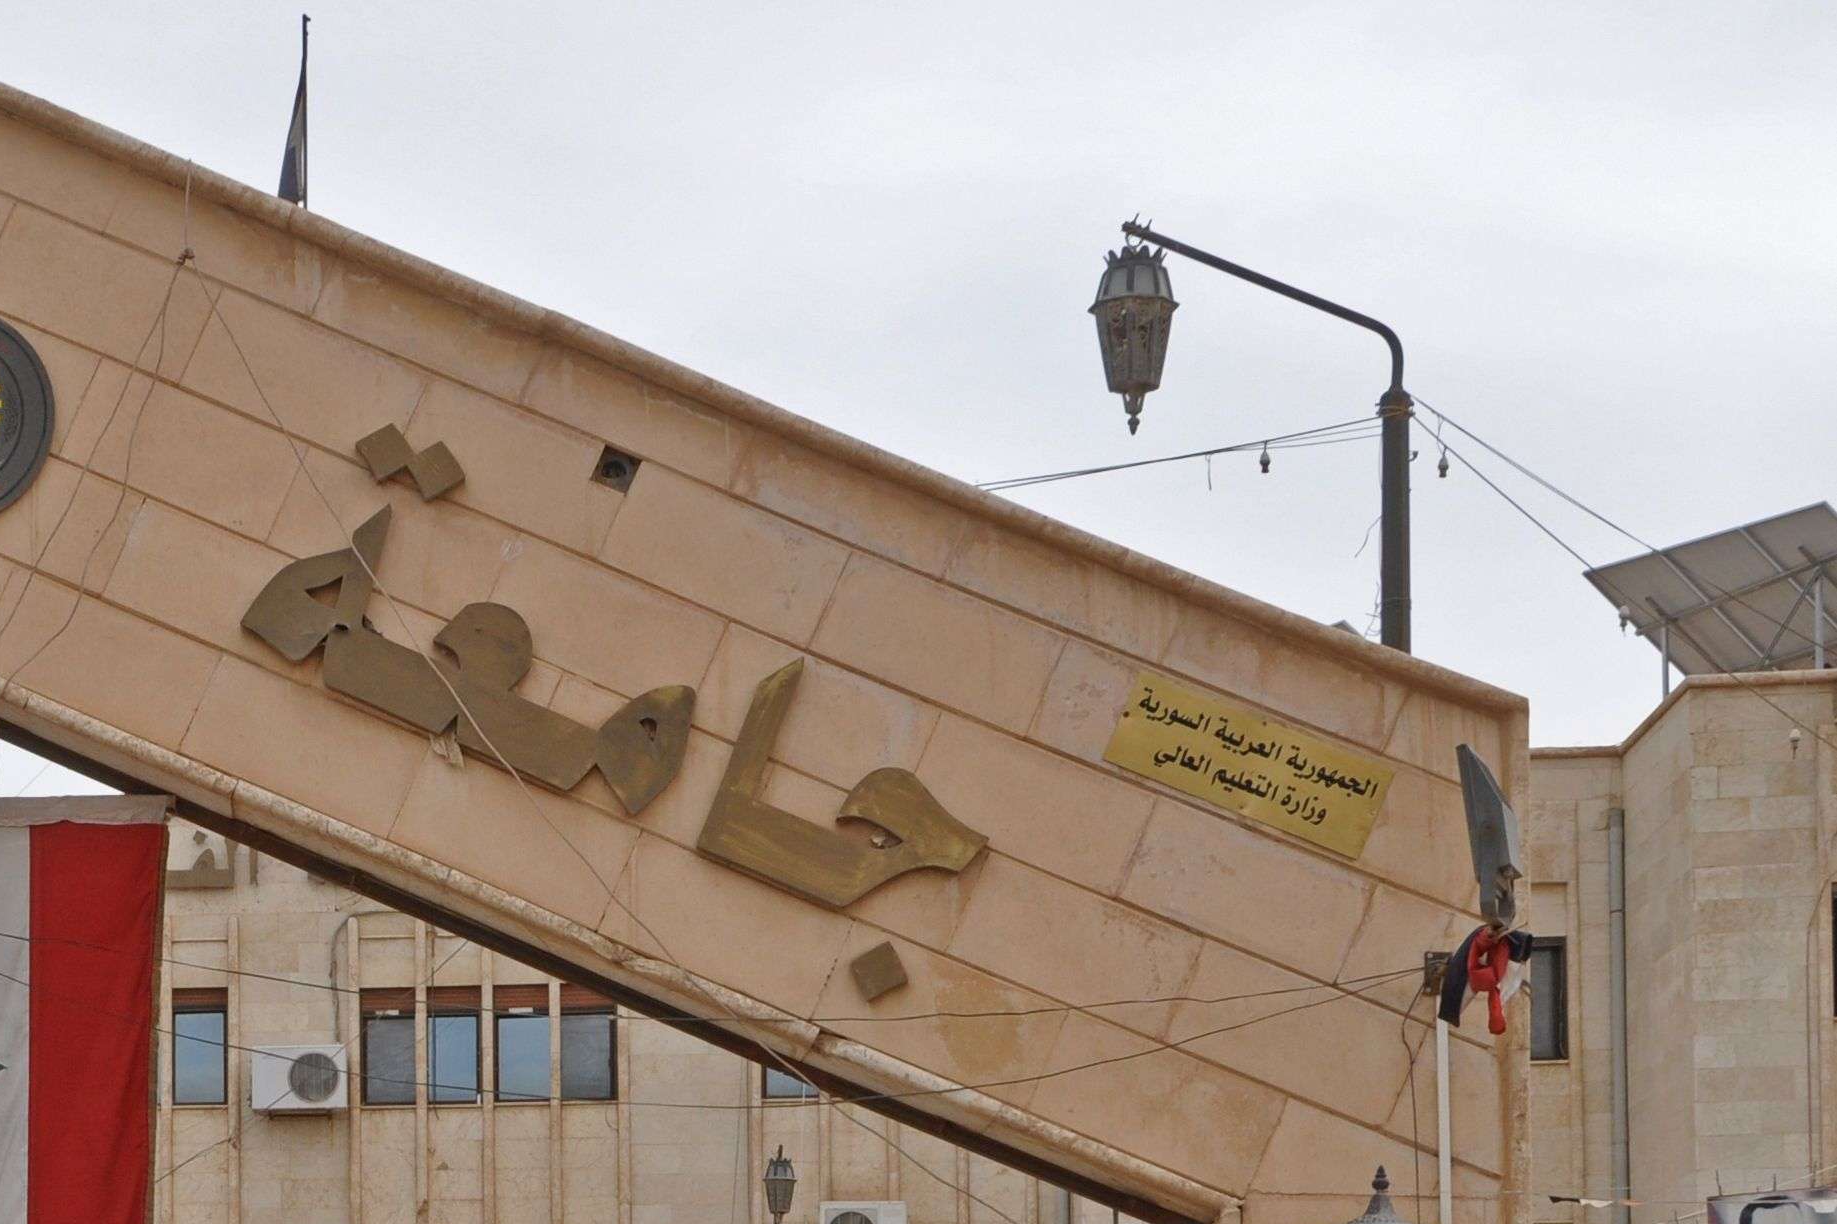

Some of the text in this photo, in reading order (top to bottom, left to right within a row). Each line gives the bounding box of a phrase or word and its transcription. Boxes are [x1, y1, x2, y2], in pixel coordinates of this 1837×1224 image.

[240, 423, 988, 1003] جامعة
[1139, 687, 1378, 799] الجمهورية العربية السورية
[1153, 745, 1327, 825] وزارة التعليم العالي
